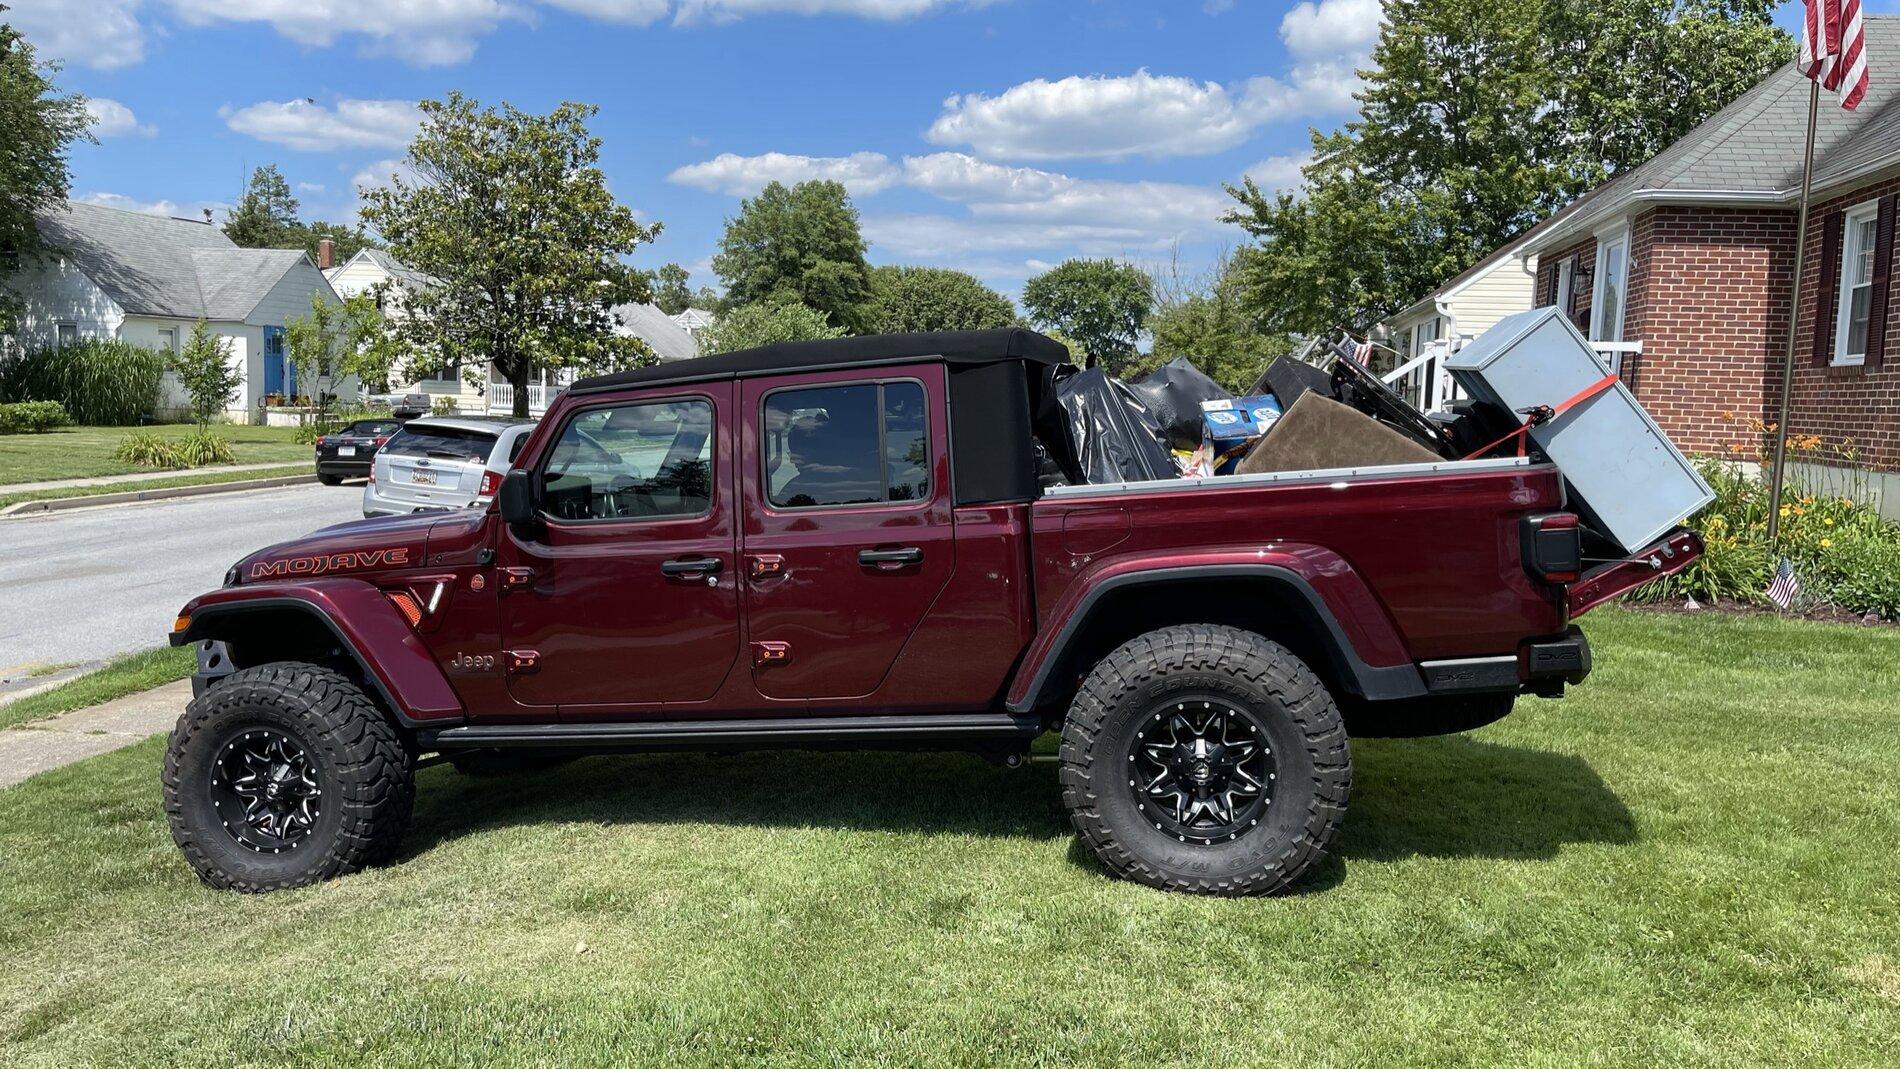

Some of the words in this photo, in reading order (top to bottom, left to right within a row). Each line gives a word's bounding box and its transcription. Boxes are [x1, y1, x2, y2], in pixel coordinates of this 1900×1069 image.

[251, 548, 408, 577] MOJAVE
[451, 651, 495, 671] Jeep
[1103, 695, 1144, 758] OPEN
[1150, 677, 1266, 705] COUNTRY
